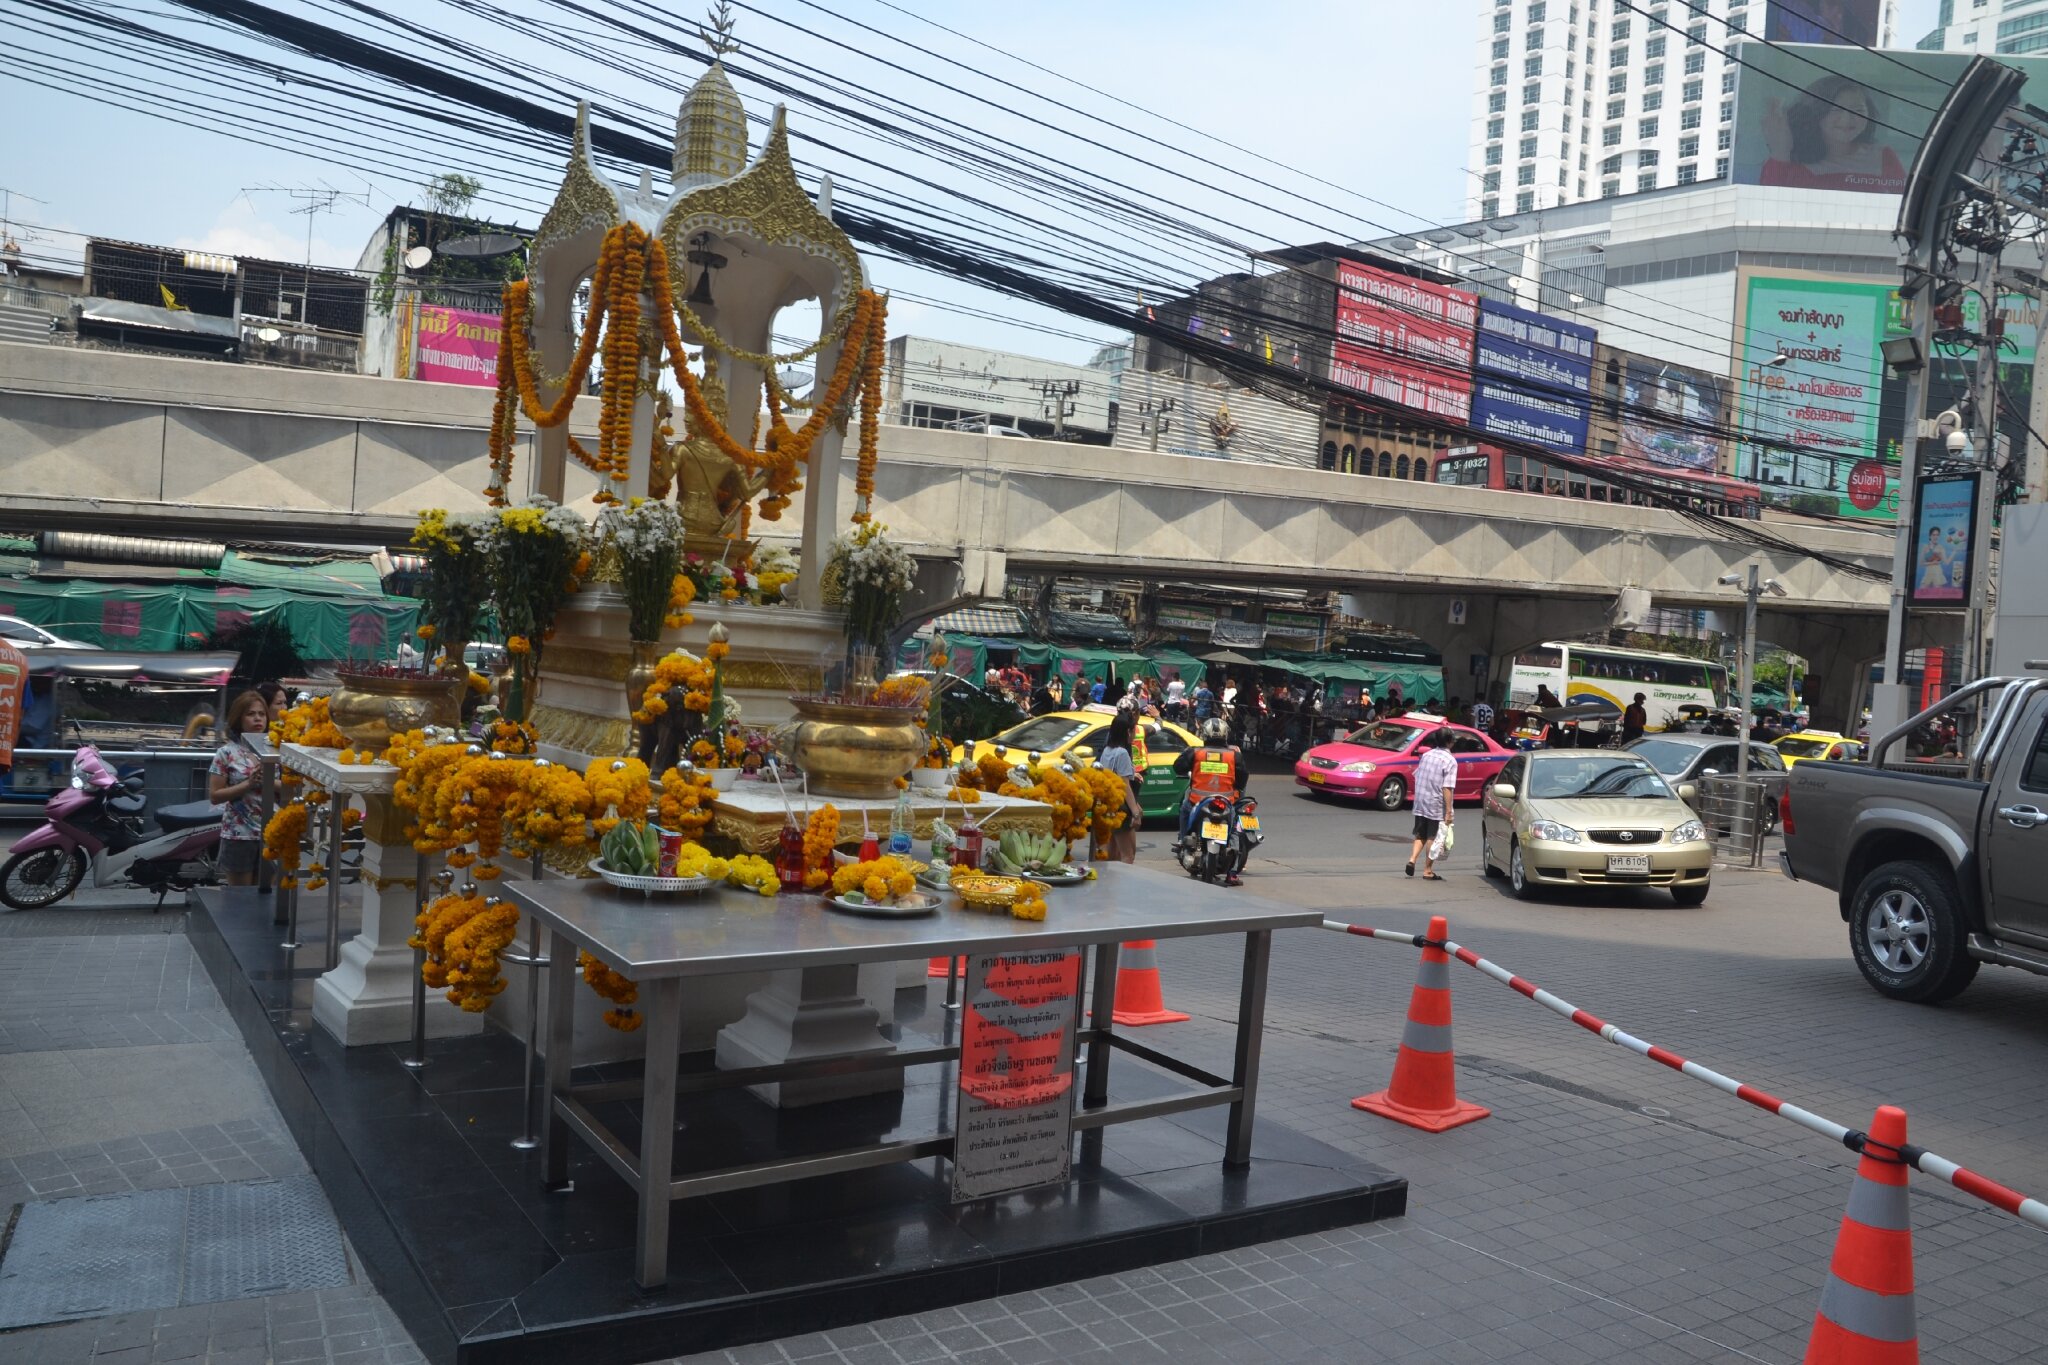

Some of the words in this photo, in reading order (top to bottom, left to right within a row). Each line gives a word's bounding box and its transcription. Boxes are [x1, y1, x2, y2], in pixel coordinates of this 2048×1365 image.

[1778, 307, 1844, 329] จองทำสัญญา
[1749, 369, 1786, 391] Free
[1453, 457, 1488, 470] 3-40327
[1626, 857, 1647, 866] 6105
[981, 953, 1065, 972] คาถาบูชาพระพรหม
[975, 1055, 1058, 1074] แล้วจึงอธิษฐานขอพร
